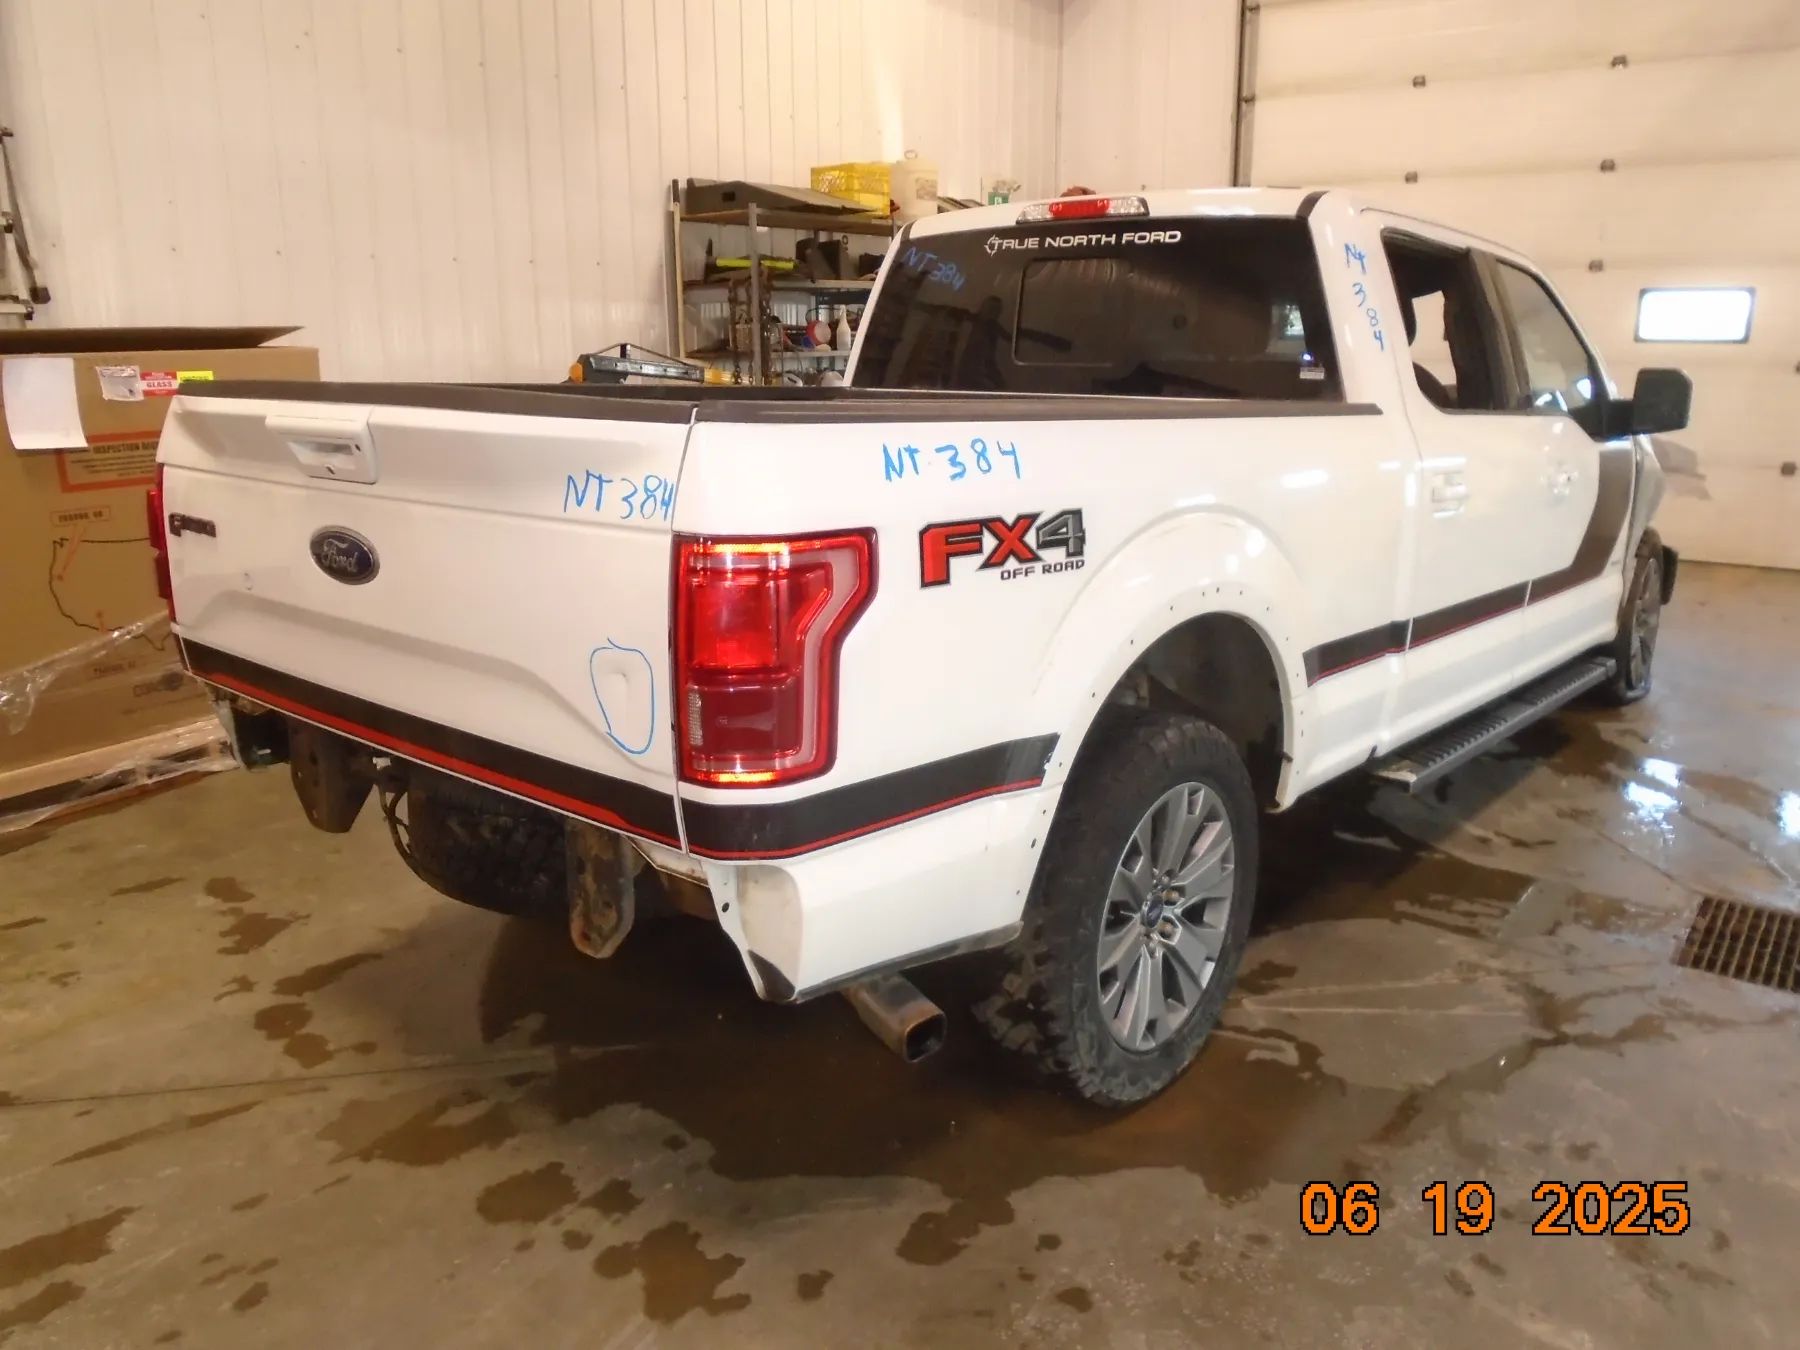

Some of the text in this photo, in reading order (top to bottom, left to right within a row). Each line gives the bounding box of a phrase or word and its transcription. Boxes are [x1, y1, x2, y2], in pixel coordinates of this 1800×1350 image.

[991, 230, 1182, 250] TRUE NORTH FORD
[882, 437, 1021, 482] NT 384
[563, 469, 674, 521] NT 384
[918, 507, 1086, 589] FX4
[1000, 559, 1086, 581] OFF ROAD
